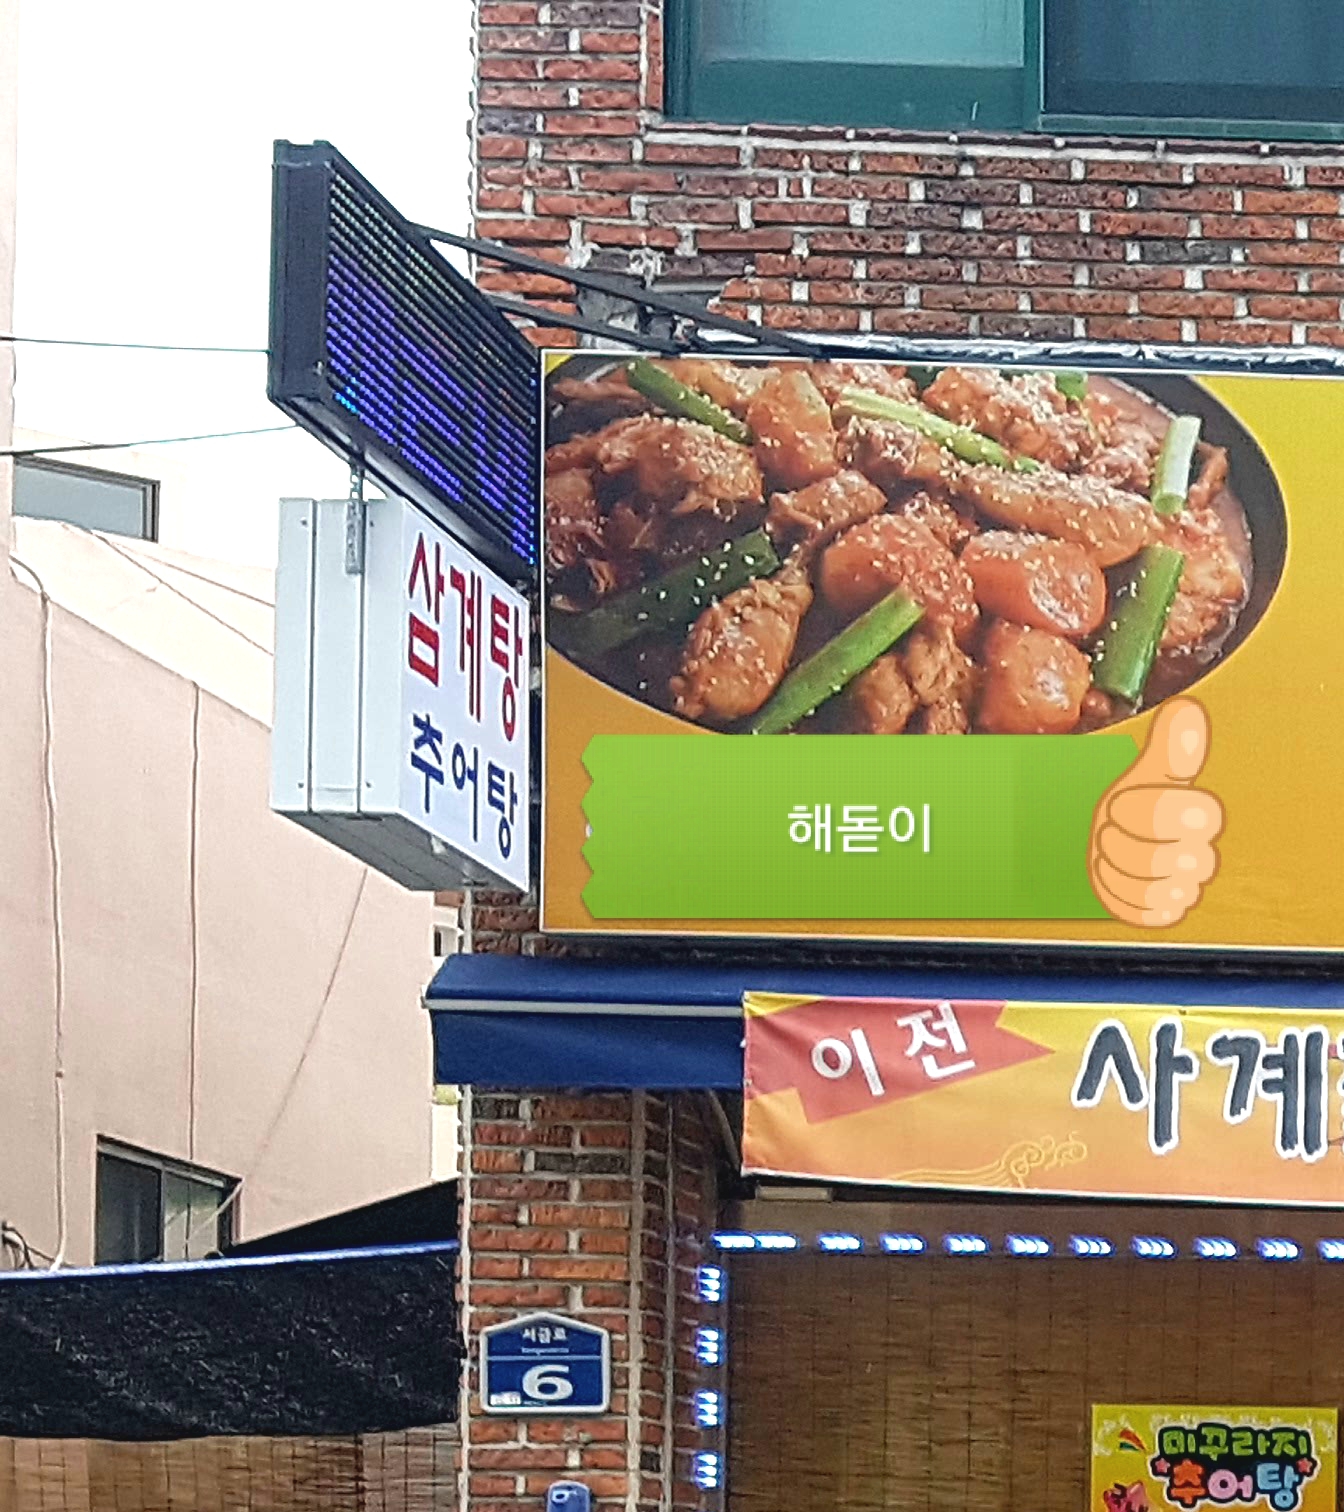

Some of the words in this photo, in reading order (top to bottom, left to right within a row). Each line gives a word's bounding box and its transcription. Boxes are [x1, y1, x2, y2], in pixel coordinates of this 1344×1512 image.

[405, 531, 526, 744] 삼계탕
[410, 713, 519, 861] 추어탕
[811, 1001, 977, 1097] 이전
[522, 1364, 573, 1400] 6
[1161, 1425, 1309, 1461] 미꾸라지
[1169, 1459, 1300, 1508] 추어탕
